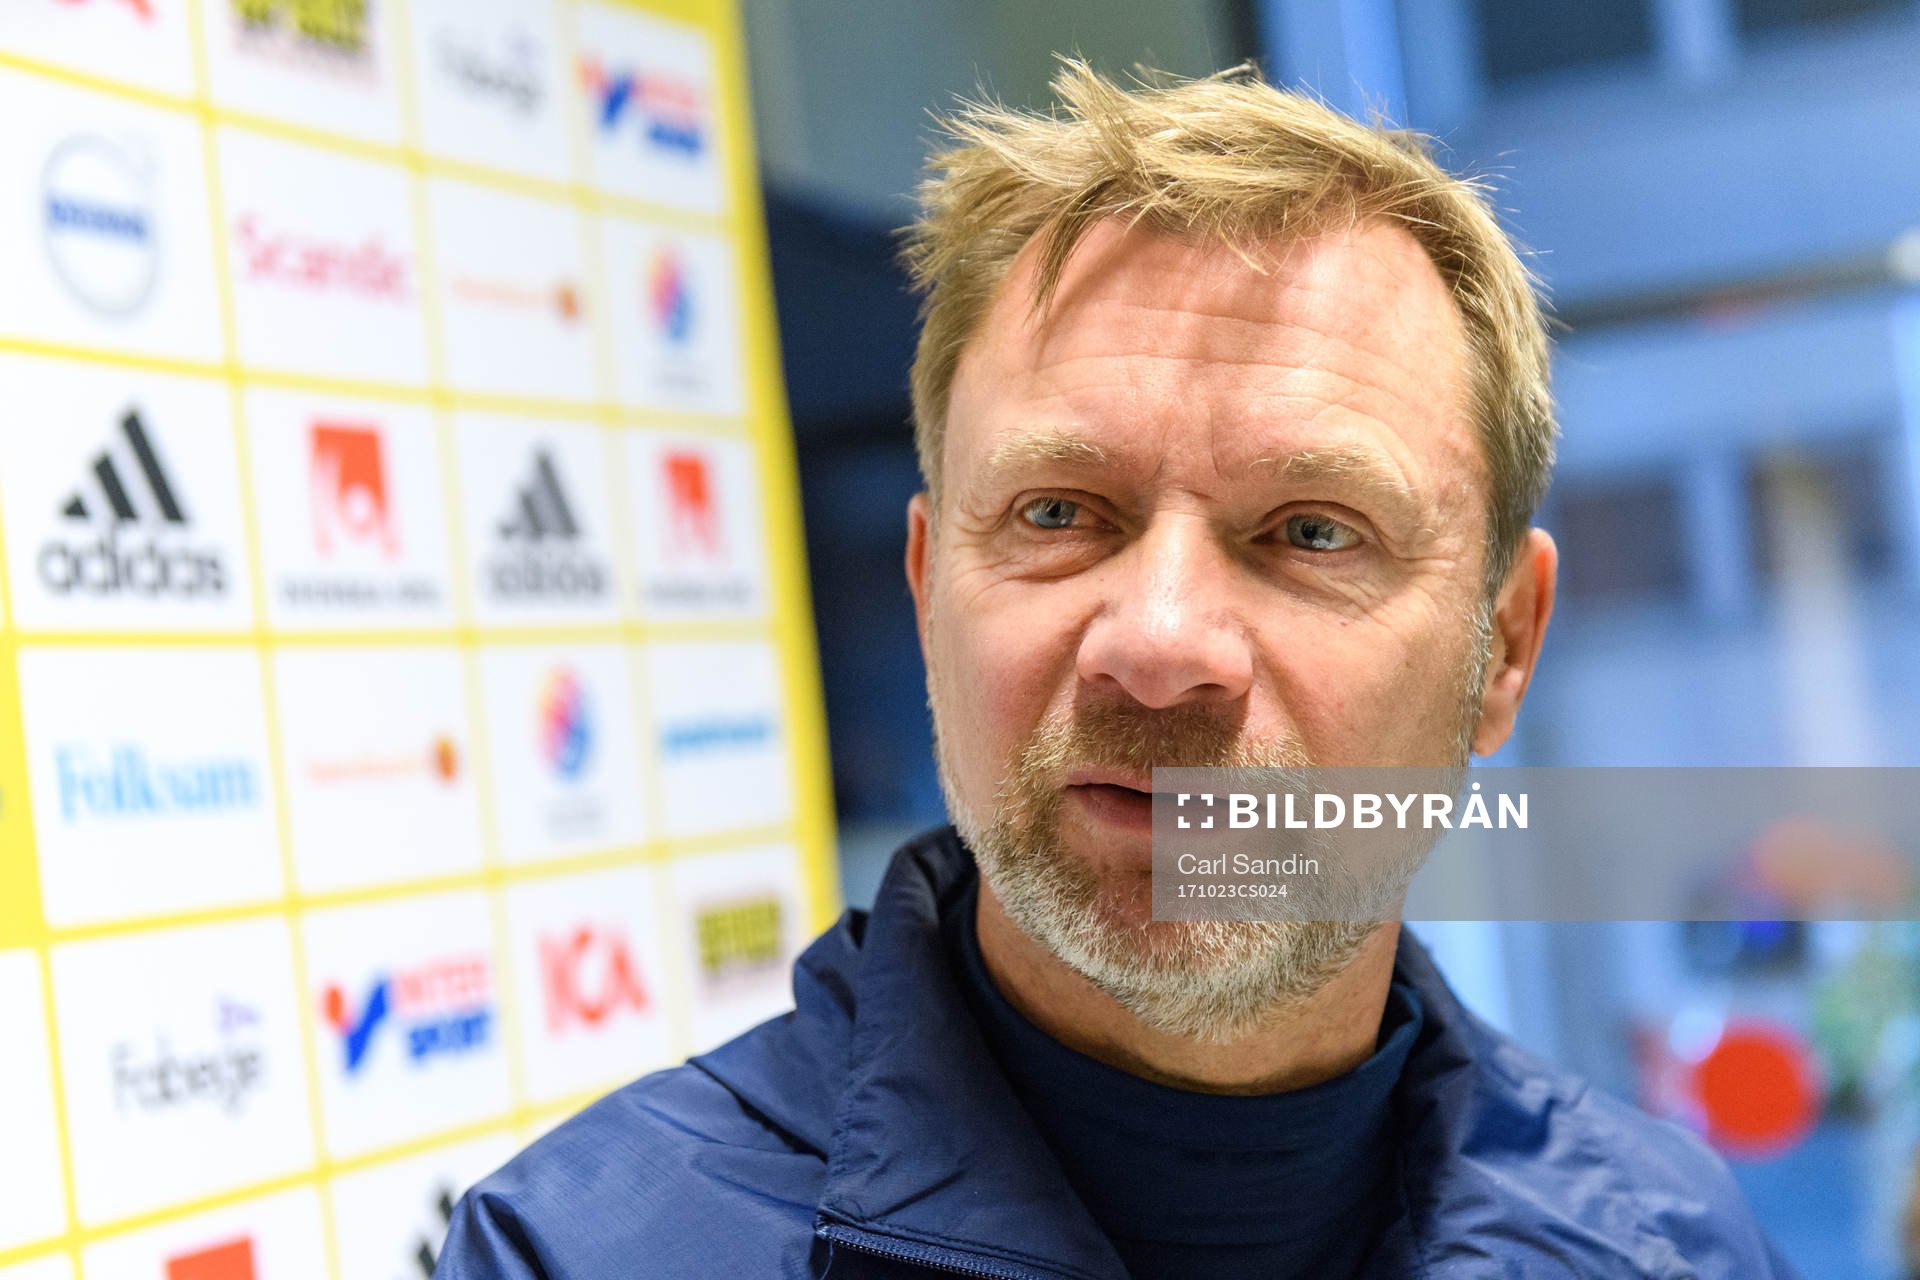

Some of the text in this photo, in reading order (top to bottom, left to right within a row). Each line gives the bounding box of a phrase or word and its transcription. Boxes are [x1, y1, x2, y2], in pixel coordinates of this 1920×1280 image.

[38, 519, 228, 599] adidas
[54, 742, 259, 823] Folksam
[537, 922, 653, 1036] ICA
[110, 1036, 266, 1117] Fabege
